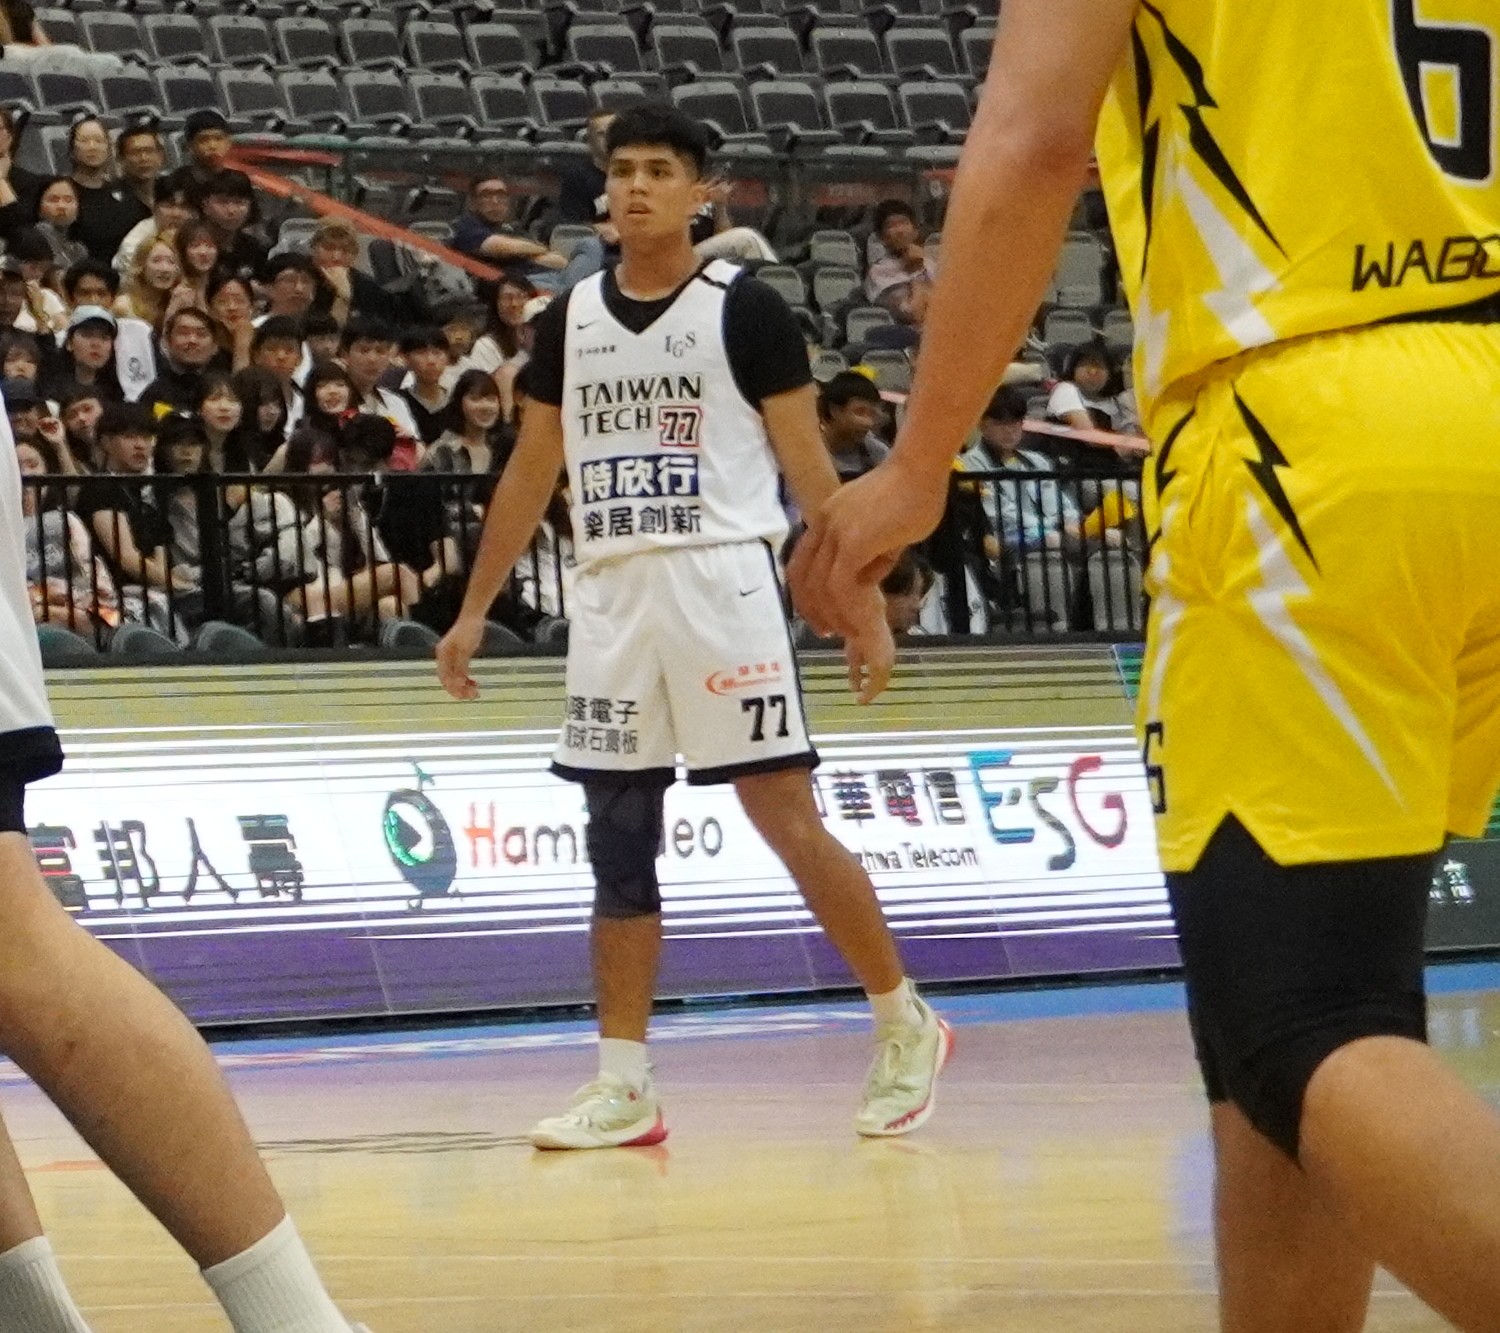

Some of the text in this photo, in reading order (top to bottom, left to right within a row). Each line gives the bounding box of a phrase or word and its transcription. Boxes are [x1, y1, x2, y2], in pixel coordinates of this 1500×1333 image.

[575, 375, 702, 409] TAIWAN
[578, 406, 702, 446] TECH 77
[582, 456, 700, 500] 特欣行
[583, 504, 700, 543] 樂居創新
[565, 695, 639, 725] 隆電子
[740, 693, 790, 742] 77
[813, 766, 967, 828] 華電信
